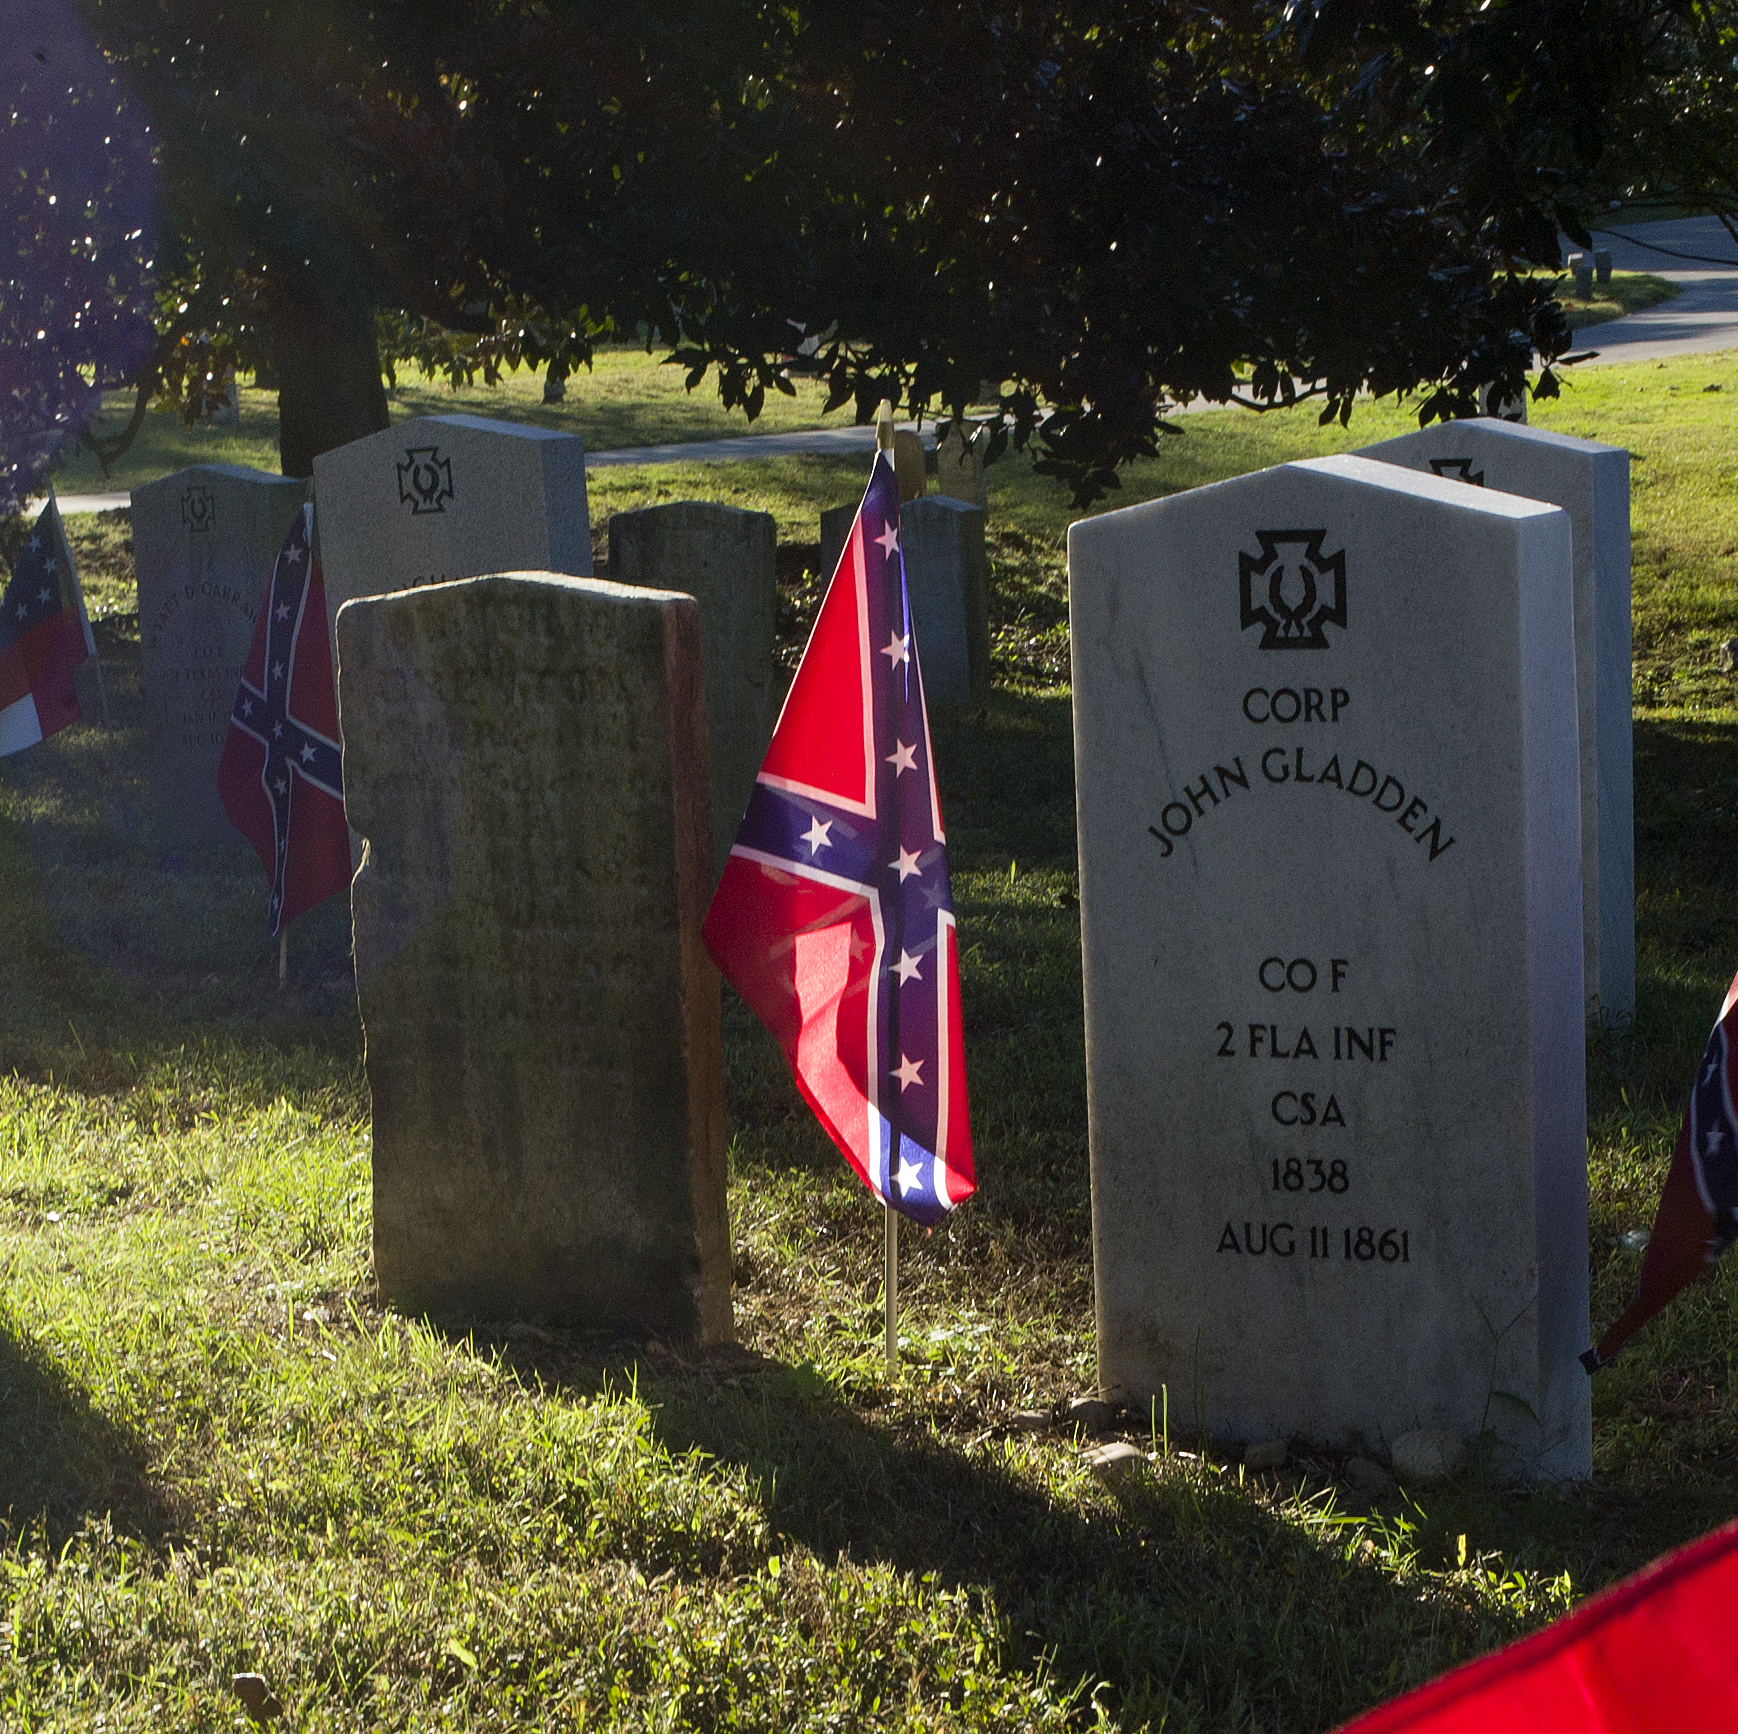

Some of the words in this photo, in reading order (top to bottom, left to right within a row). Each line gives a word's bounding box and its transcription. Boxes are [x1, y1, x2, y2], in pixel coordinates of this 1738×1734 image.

[1242, 687, 1351, 724] CORP
[1148, 756, 1250, 858] JOHN
[1261, 746, 1455, 862] GLADDEN
[1258, 957, 1317, 993] CO
[1331, 959, 1348, 993] F
[1216, 1021, 1236, 1058] 2
[1248, 1024, 1318, 1059] FLA
[1333, 1026, 1396, 1062] INF
[1271, 1091, 1346, 1127] CSA
[1271, 1158, 1350, 1194] 1838
[1216, 1221, 1296, 1258] AUG
[1310, 1225, 1330, 1259] 11
[1344, 1227, 1410, 1262] 1861
